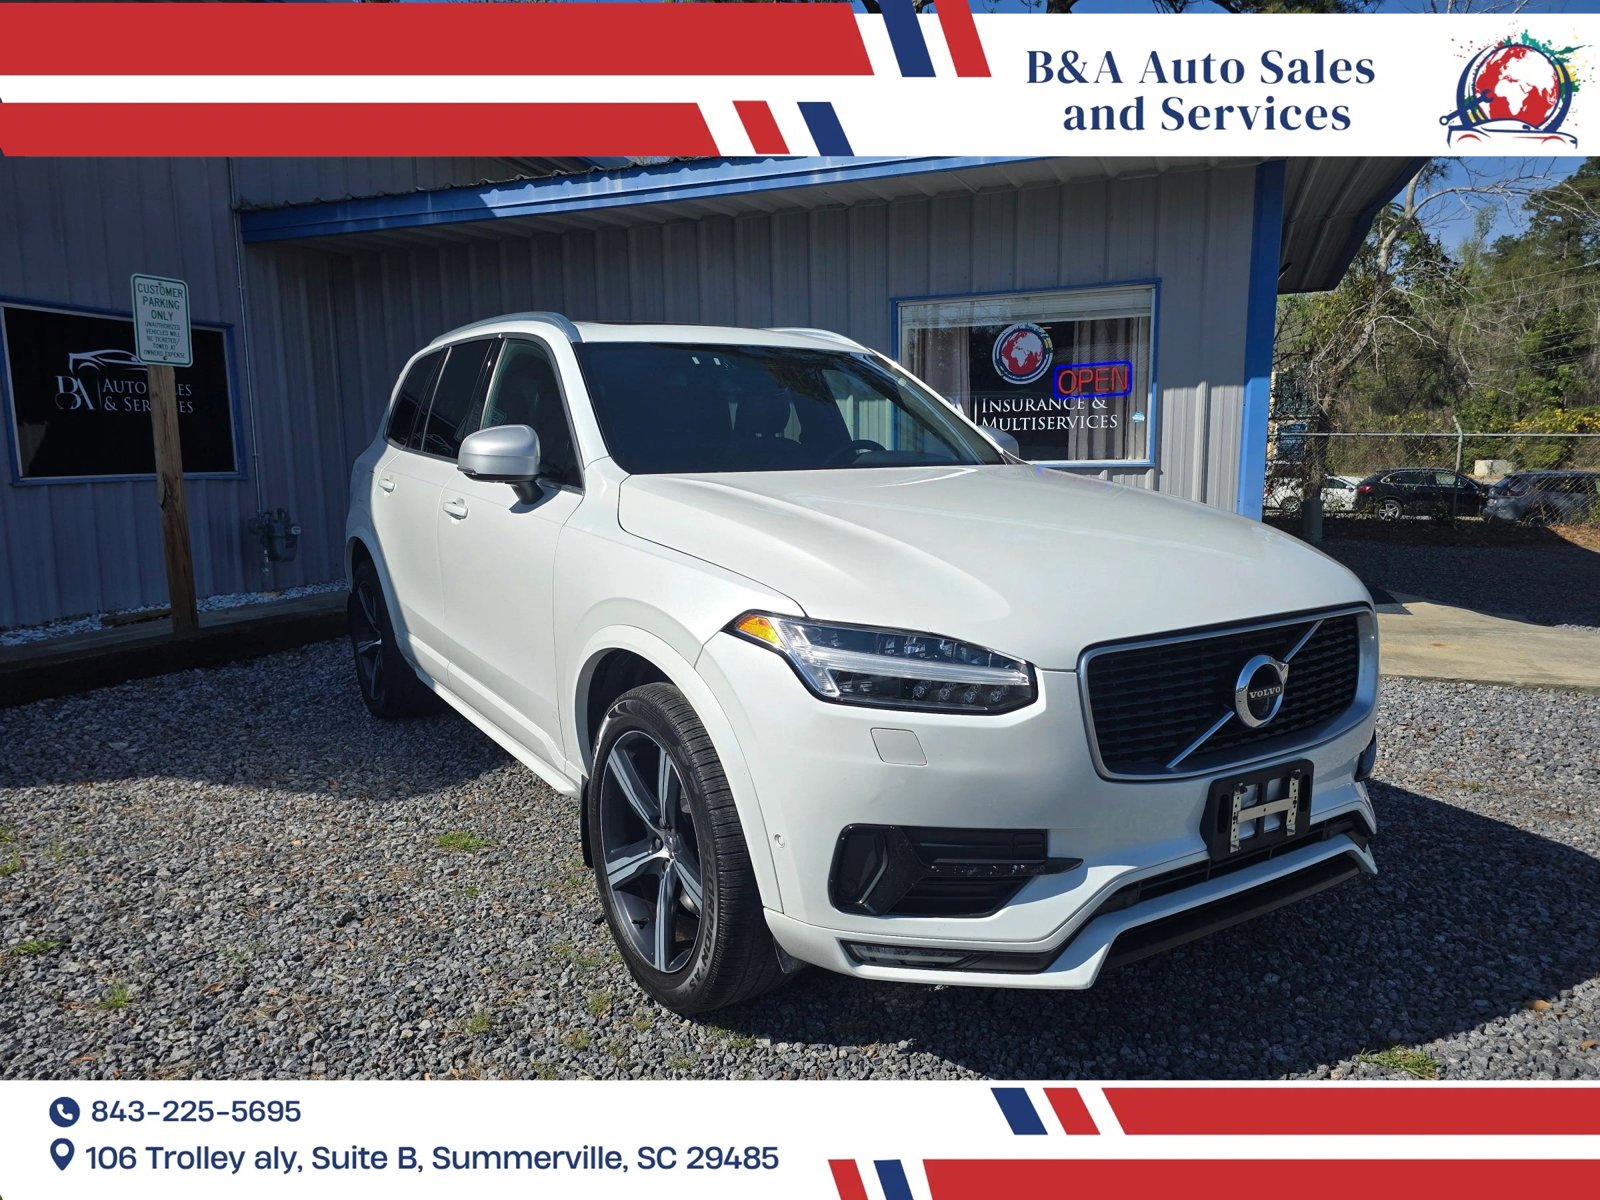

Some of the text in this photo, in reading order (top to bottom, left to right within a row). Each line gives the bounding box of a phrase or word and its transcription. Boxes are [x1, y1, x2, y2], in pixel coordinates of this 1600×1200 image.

[137, 282, 184, 299] CUSTOMER
[142, 295, 180, 310] PARKING
[150, 309, 174, 321] ONLY
[1057, 366, 1128, 395] OPEN
[104, 396, 118, 411] &
[1091, 396, 1109, 410] &
[1249, 686, 1281, 699] VOLVO
